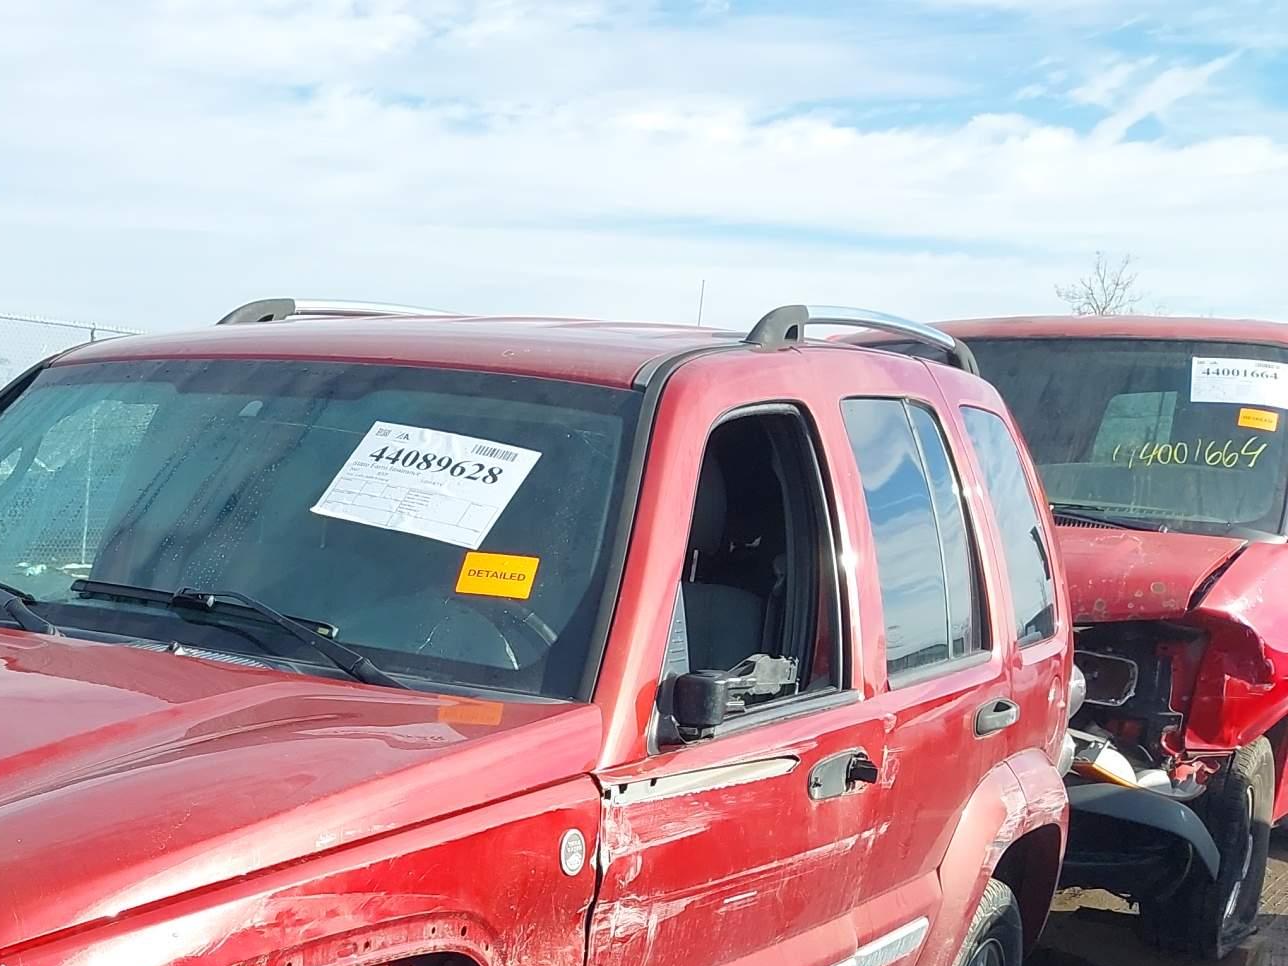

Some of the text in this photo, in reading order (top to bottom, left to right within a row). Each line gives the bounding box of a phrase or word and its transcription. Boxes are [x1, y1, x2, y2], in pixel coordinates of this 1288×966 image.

[1201, 367, 1279, 380] 44001664
[369, 445, 504, 485] 44089628
[467, 568, 527, 582] DETAILED
